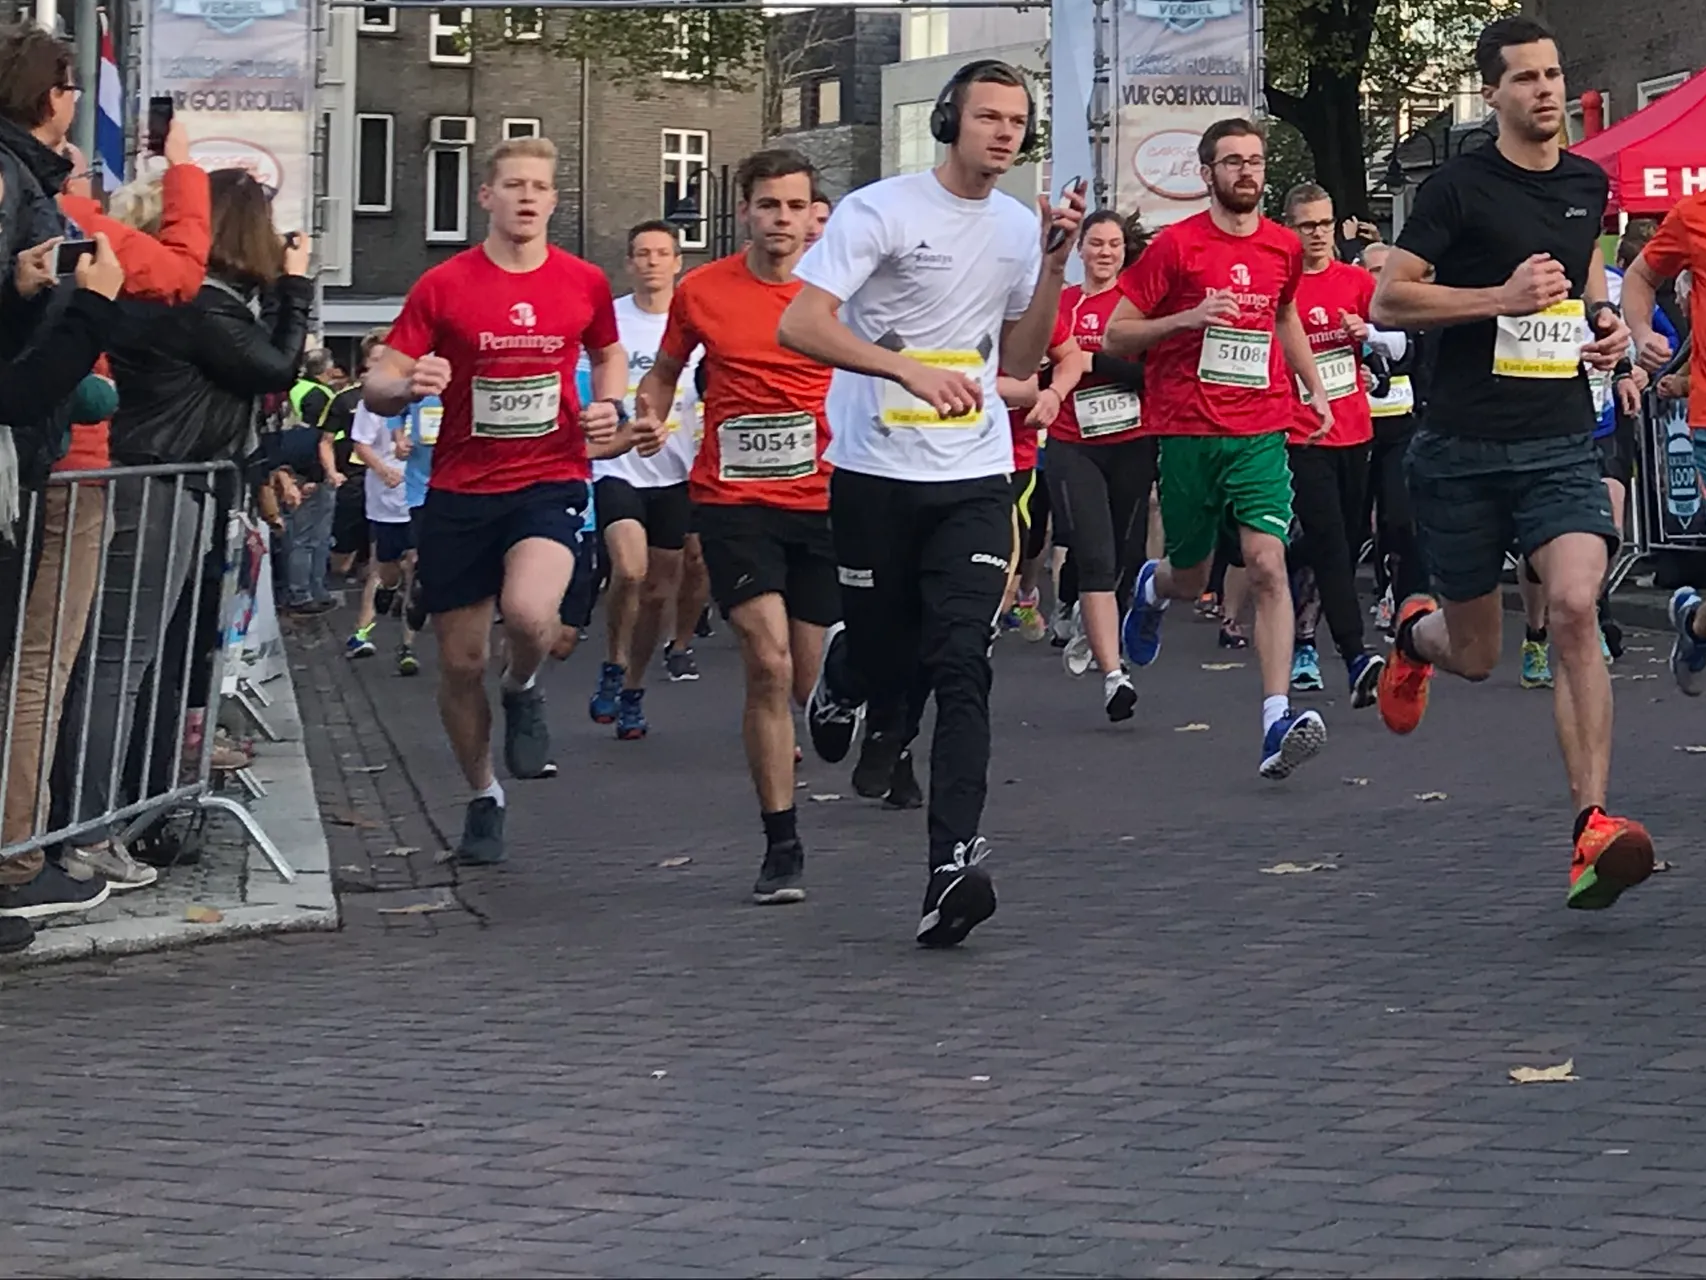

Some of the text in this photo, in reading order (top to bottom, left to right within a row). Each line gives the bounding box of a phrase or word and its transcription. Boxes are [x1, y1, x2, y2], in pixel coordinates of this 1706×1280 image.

[1159, 3, 1214, 16] VEGHEL
[1122, 85, 1149, 105] VUR
[1190, 85, 1249, 106] KROLLEN
[479, 329, 565, 353] Pennings
[1518, 321, 1572, 343] 2042
[1218, 343, 1261, 366] 5108
[489, 393, 543, 412] 5097
[1088, 395, 1127, 415] 5105
[738, 433, 797, 452] 5054
